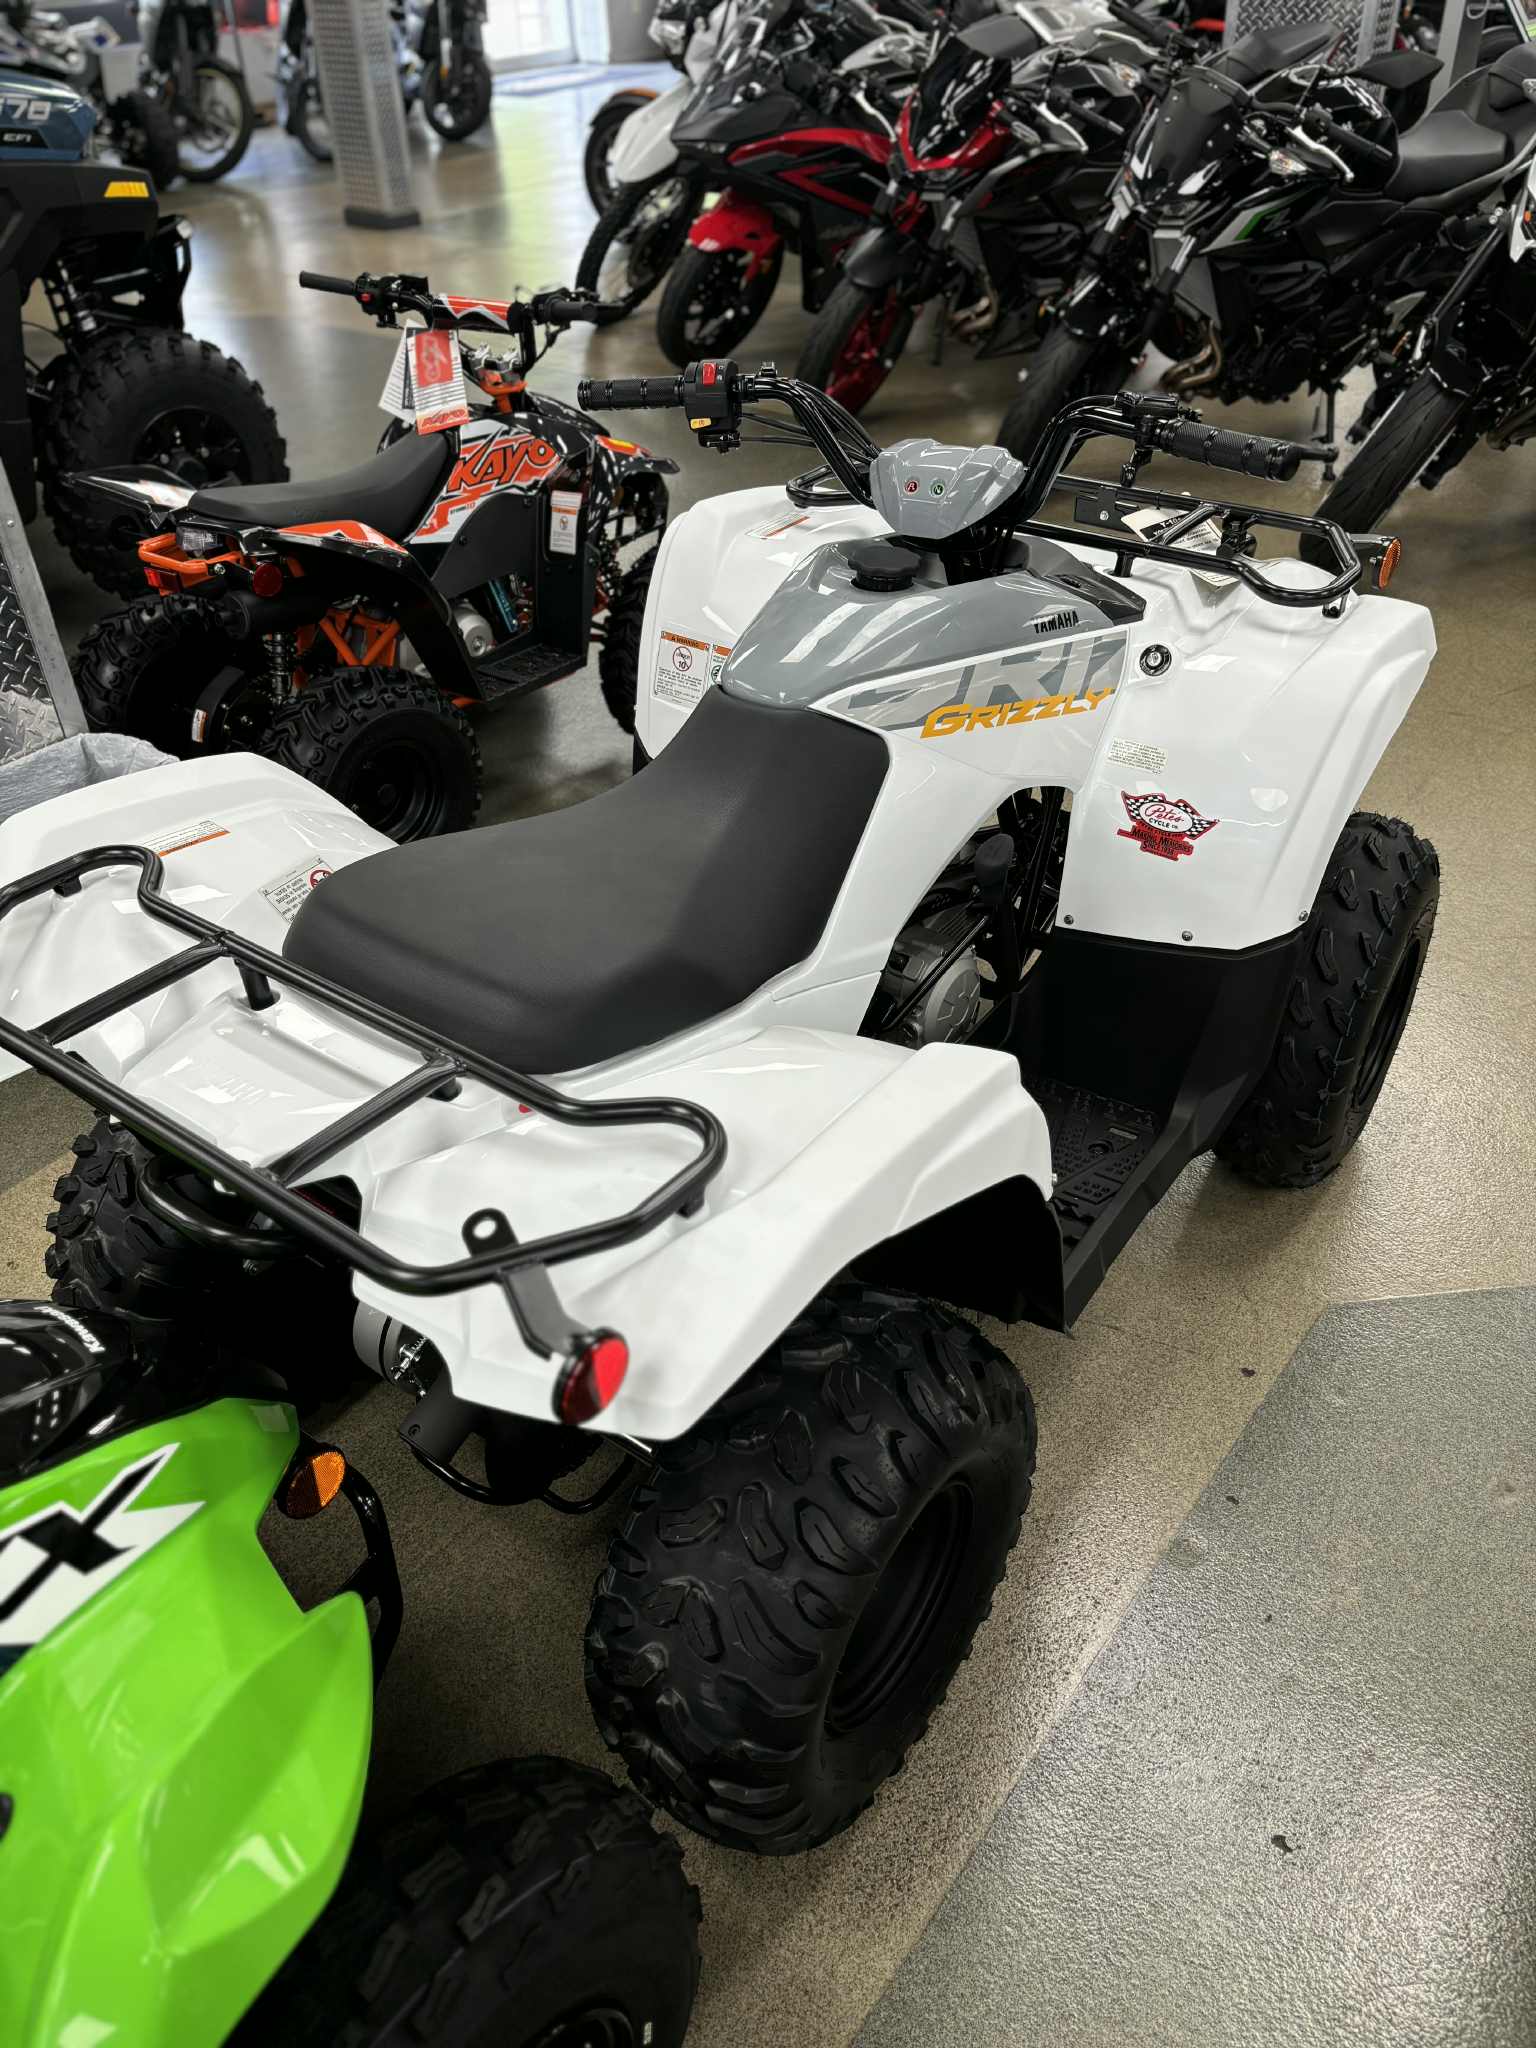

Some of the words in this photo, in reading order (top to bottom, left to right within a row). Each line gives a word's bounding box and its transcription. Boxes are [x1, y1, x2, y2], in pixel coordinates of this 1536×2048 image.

[1033, 610, 1080, 634] YAMAHA
[920, 687, 1117, 739] GRIZZLY
[1149, 817, 1170, 828] CYCLE
